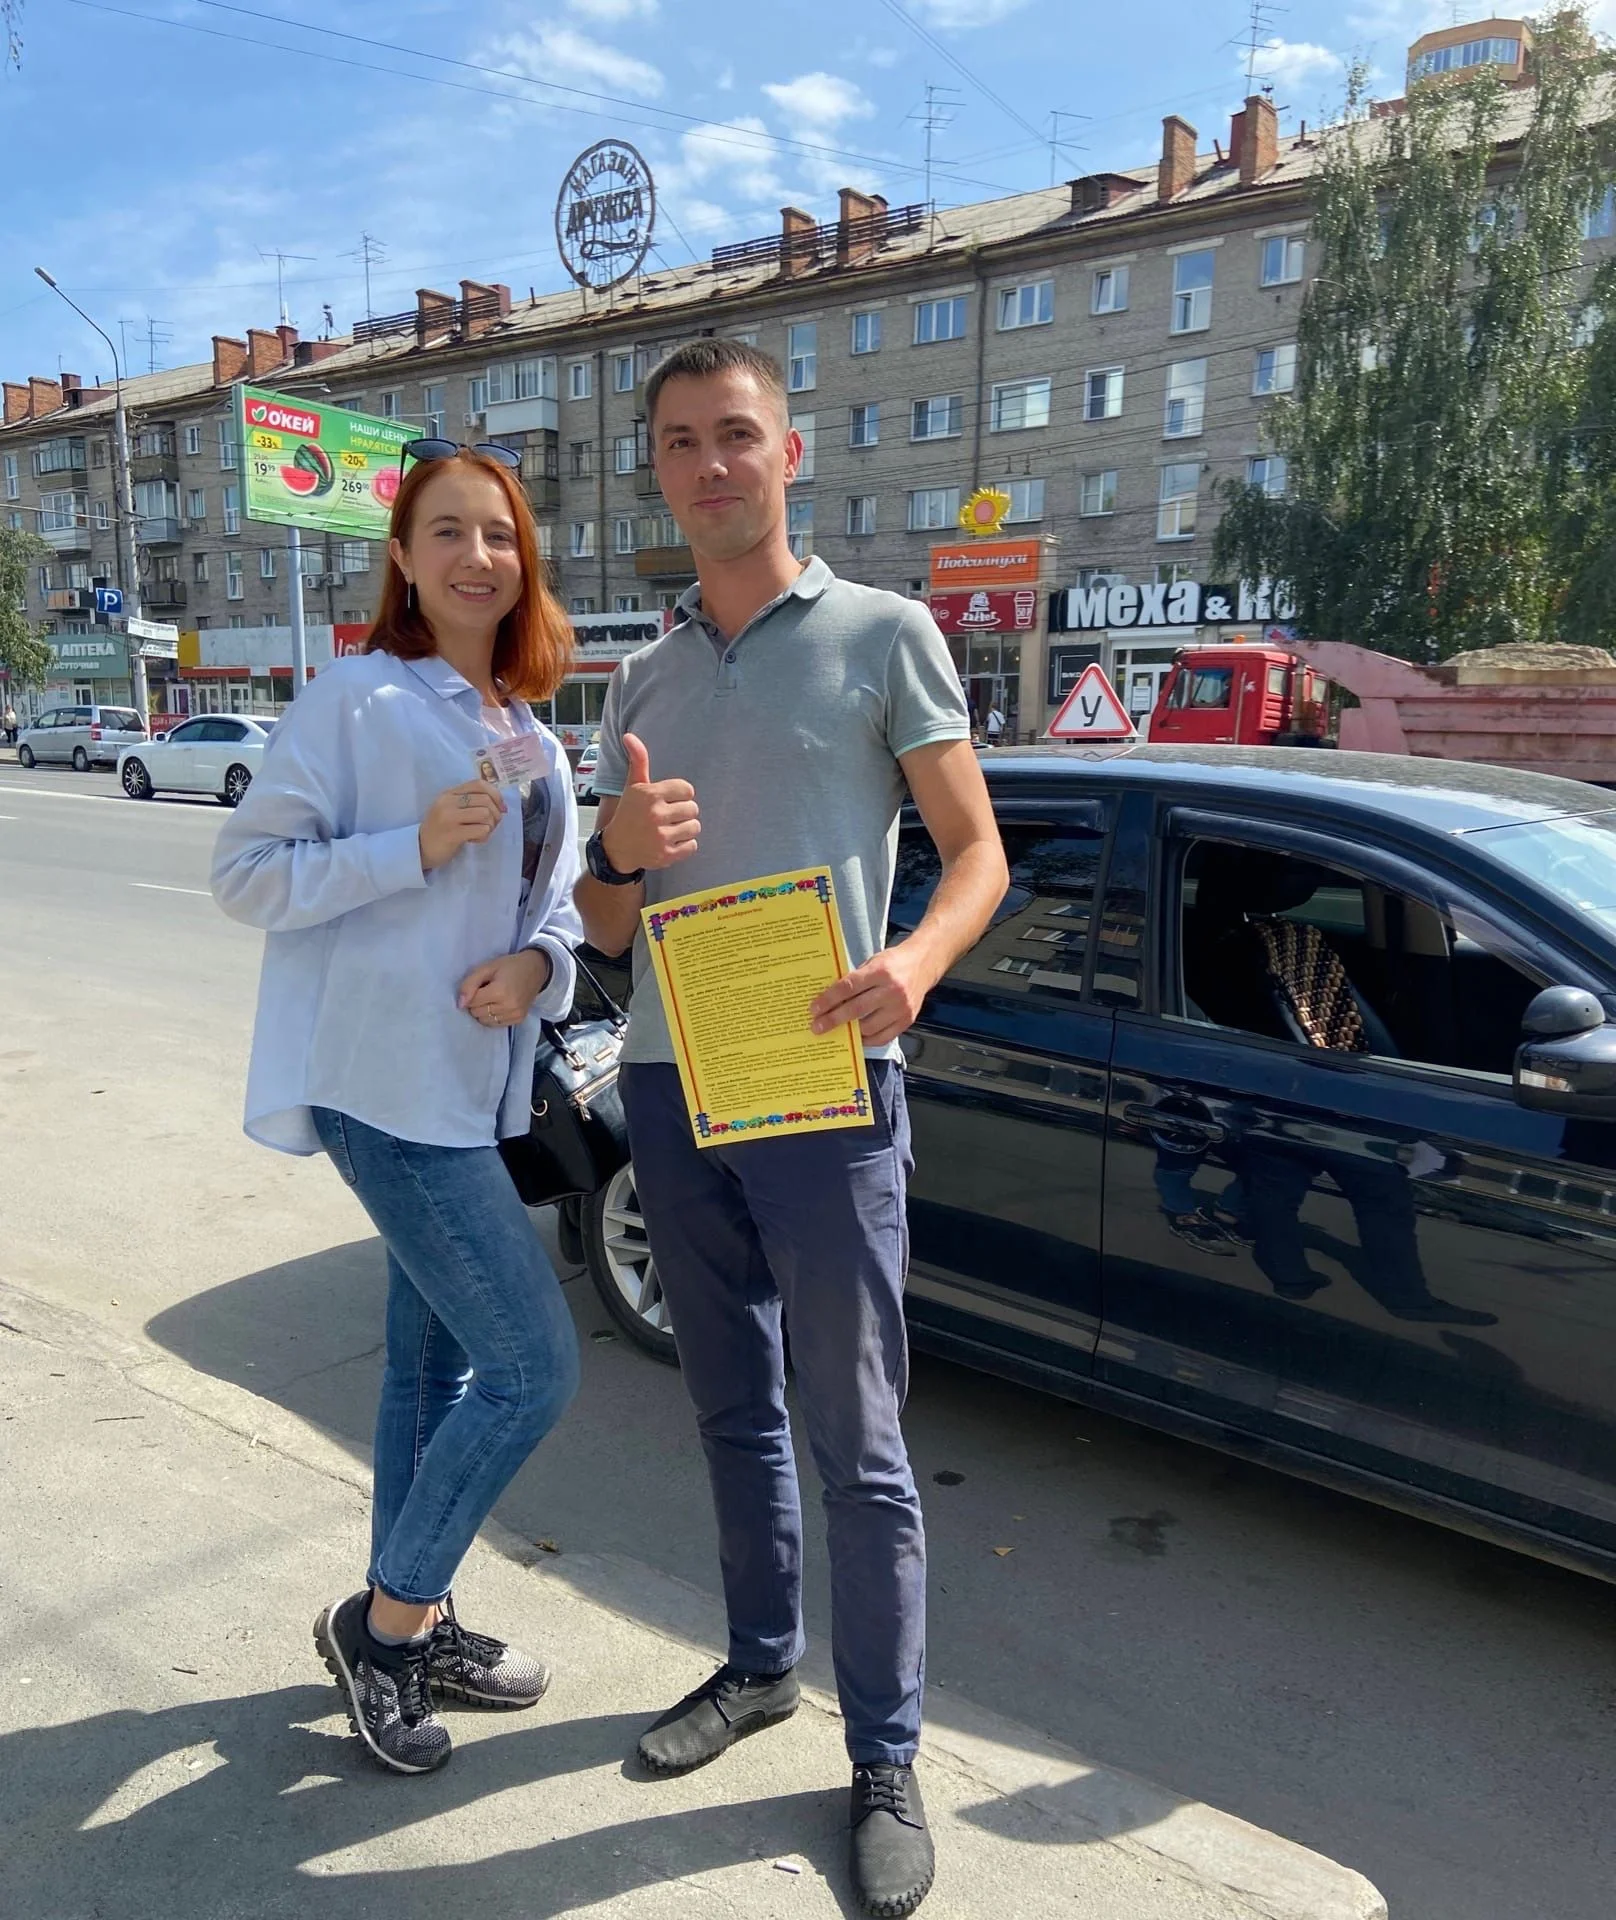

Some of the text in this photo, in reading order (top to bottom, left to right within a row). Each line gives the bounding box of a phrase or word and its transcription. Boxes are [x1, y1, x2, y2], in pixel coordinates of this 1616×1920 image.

[350, 422, 408, 444] НАШИ ЦЕНЫ
[1205, 596, 1232, 620] &
[61, 643, 116, 657] АПТЕКА
[1081, 695, 1103, 727] У
